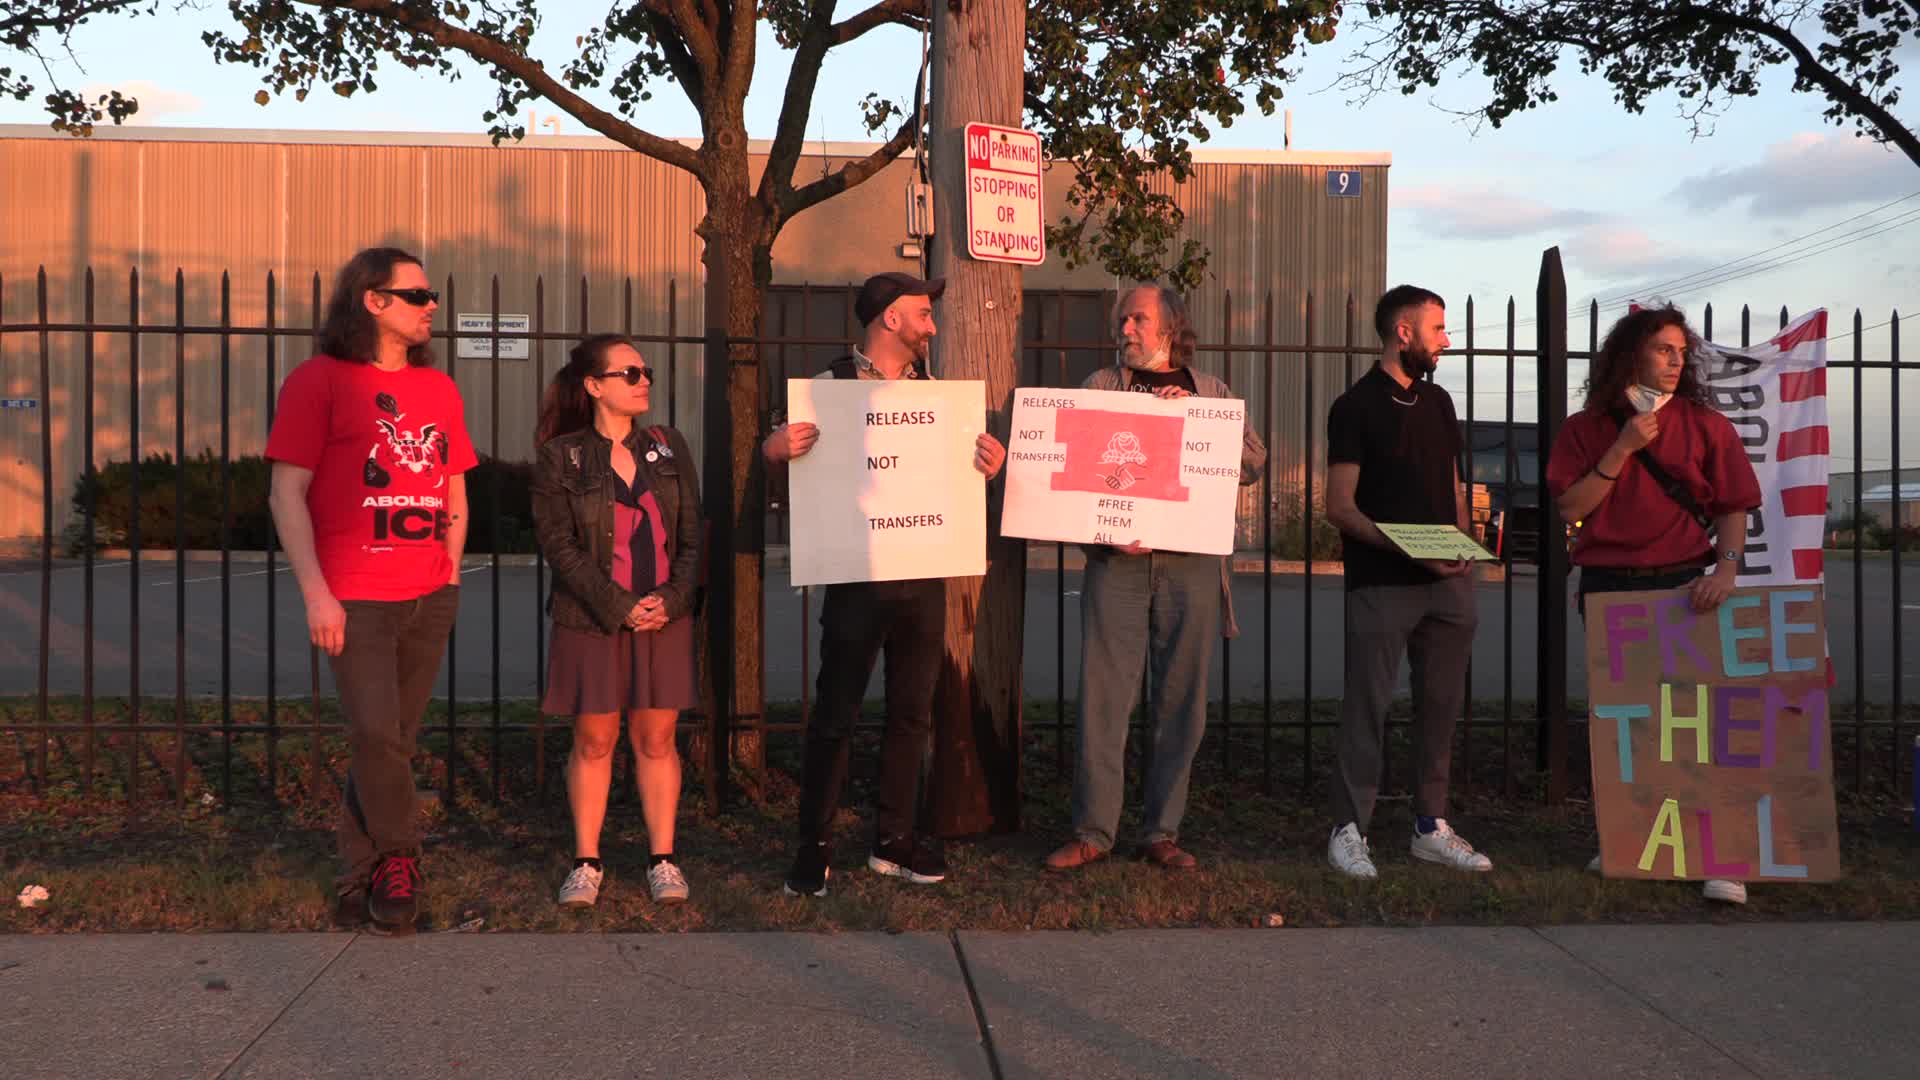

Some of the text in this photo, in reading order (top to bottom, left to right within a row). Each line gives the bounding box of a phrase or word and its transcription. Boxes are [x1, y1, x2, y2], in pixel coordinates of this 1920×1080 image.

[970, 134, 1036, 163] NO PARKING
[973, 176, 1037, 200] STOPPING
[1339, 172, 1349, 193] 9
[997, 206, 1015, 223] OR
[975, 230, 1038, 252] STANDING
[1022, 397, 1076, 409] RELEASES
[866, 411, 935, 426] RELEASES
[1187, 408, 1242, 421] RELEASES
[1019, 430, 1045, 441] NOT
[1185, 441, 1212, 453] NOT
[867, 456, 899, 470] NOT
[1011, 451, 1066, 463] TRANSFERS
[1183, 464, 1240, 478] TRANSFERS
[362, 495, 443, 507] ABOLISH
[1098, 498, 1135, 511] #FREE
[870, 514, 943, 530] TRANSFERS
[1096, 515, 1132, 528] THEM
[1094, 532, 1114, 544] ALL
[1604, 591, 1817, 684] FREE
[1594, 683, 1827, 783] THEM
[1638, 794, 1809, 878] ALL
